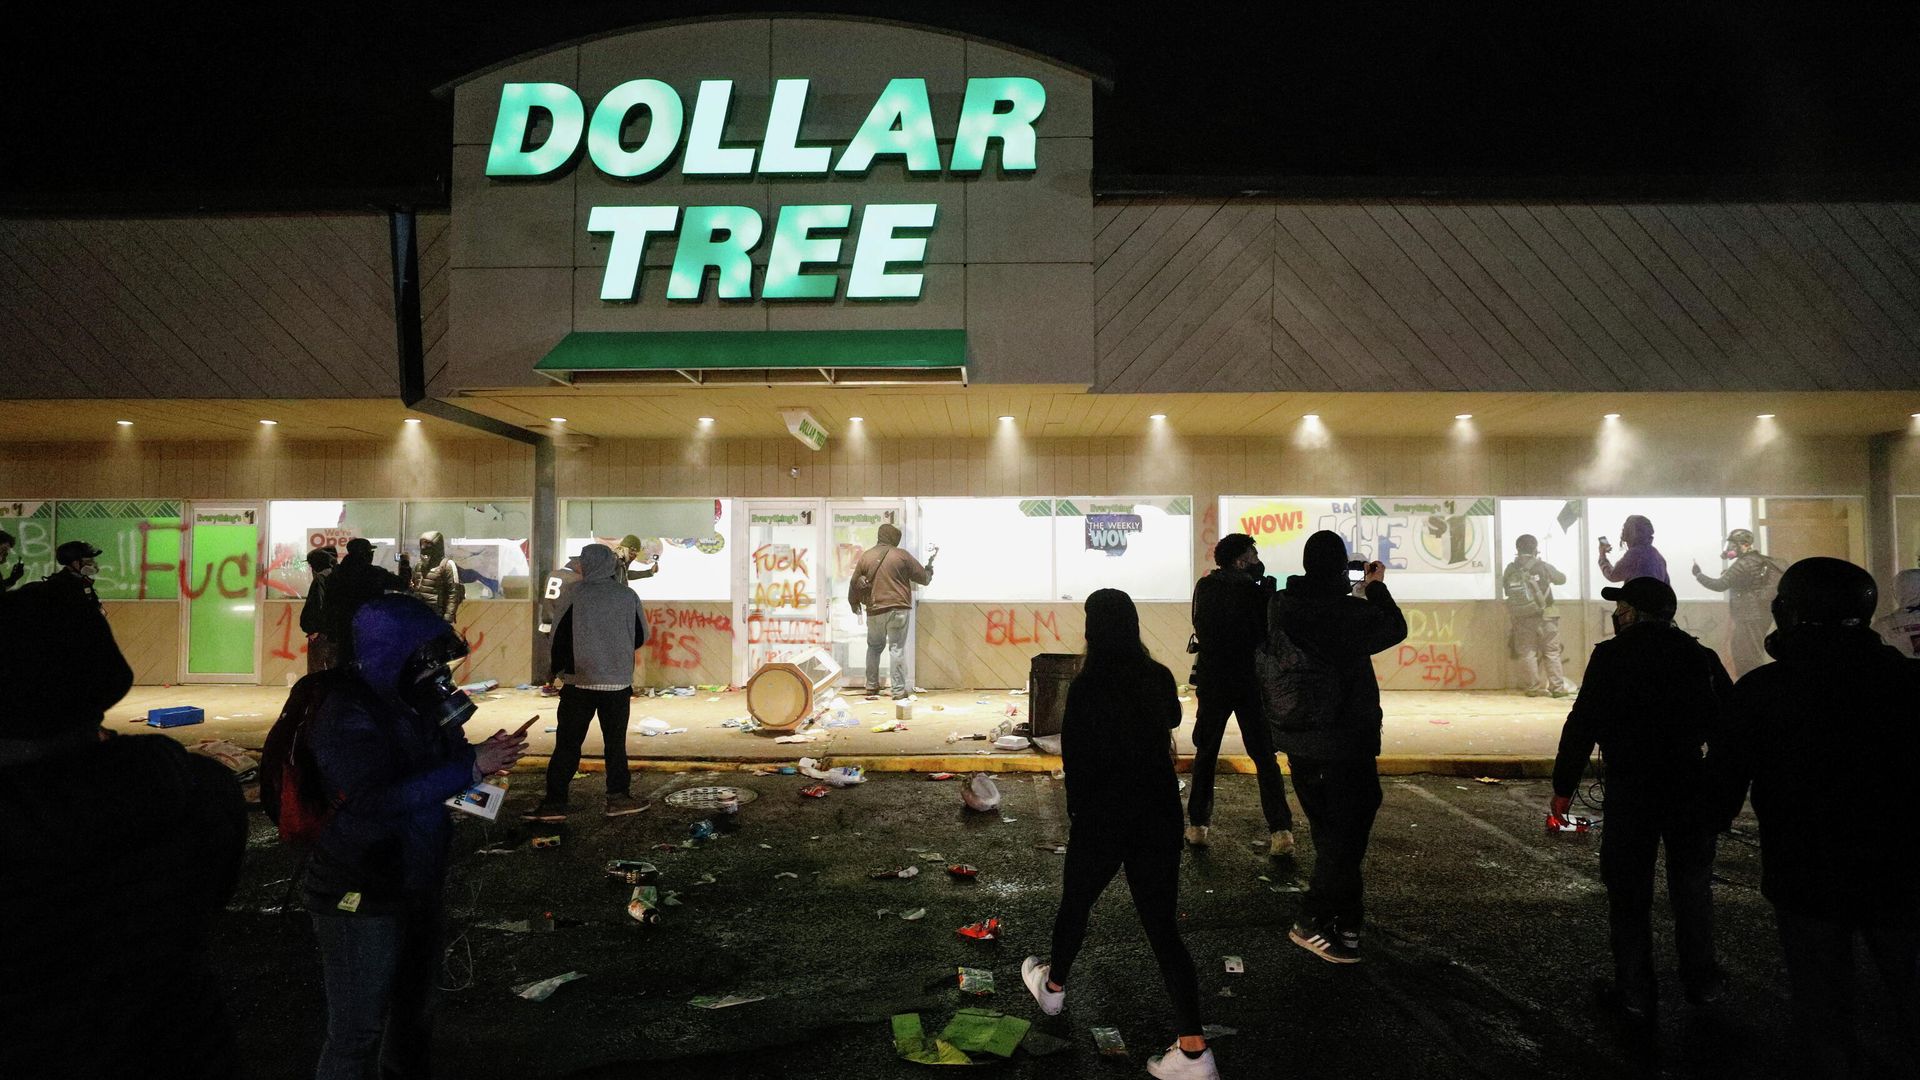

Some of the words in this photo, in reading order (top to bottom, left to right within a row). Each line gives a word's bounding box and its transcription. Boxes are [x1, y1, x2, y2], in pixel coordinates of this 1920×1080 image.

[485, 77, 1046, 177] DOLLAR
[587, 203, 937, 301] TREE
[752, 514, 798, 524] Everything's
[801, 511, 812, 524] $1
[835, 514, 881, 524] Everything's
[884, 511, 895, 524] $1
[1089, 521, 1104, 530] THE
[1107, 521, 1141, 530] WEEKLY
[1240, 511, 1304, 537] WOW!
[310, 534, 354, 548] Ope
[325, 529, 351, 537] We're
[1427, 515, 1468, 564] $1
[545, 577, 562, 599] B
[755, 579, 812, 609] ACAB
[985, 608, 1061, 646] BLM
